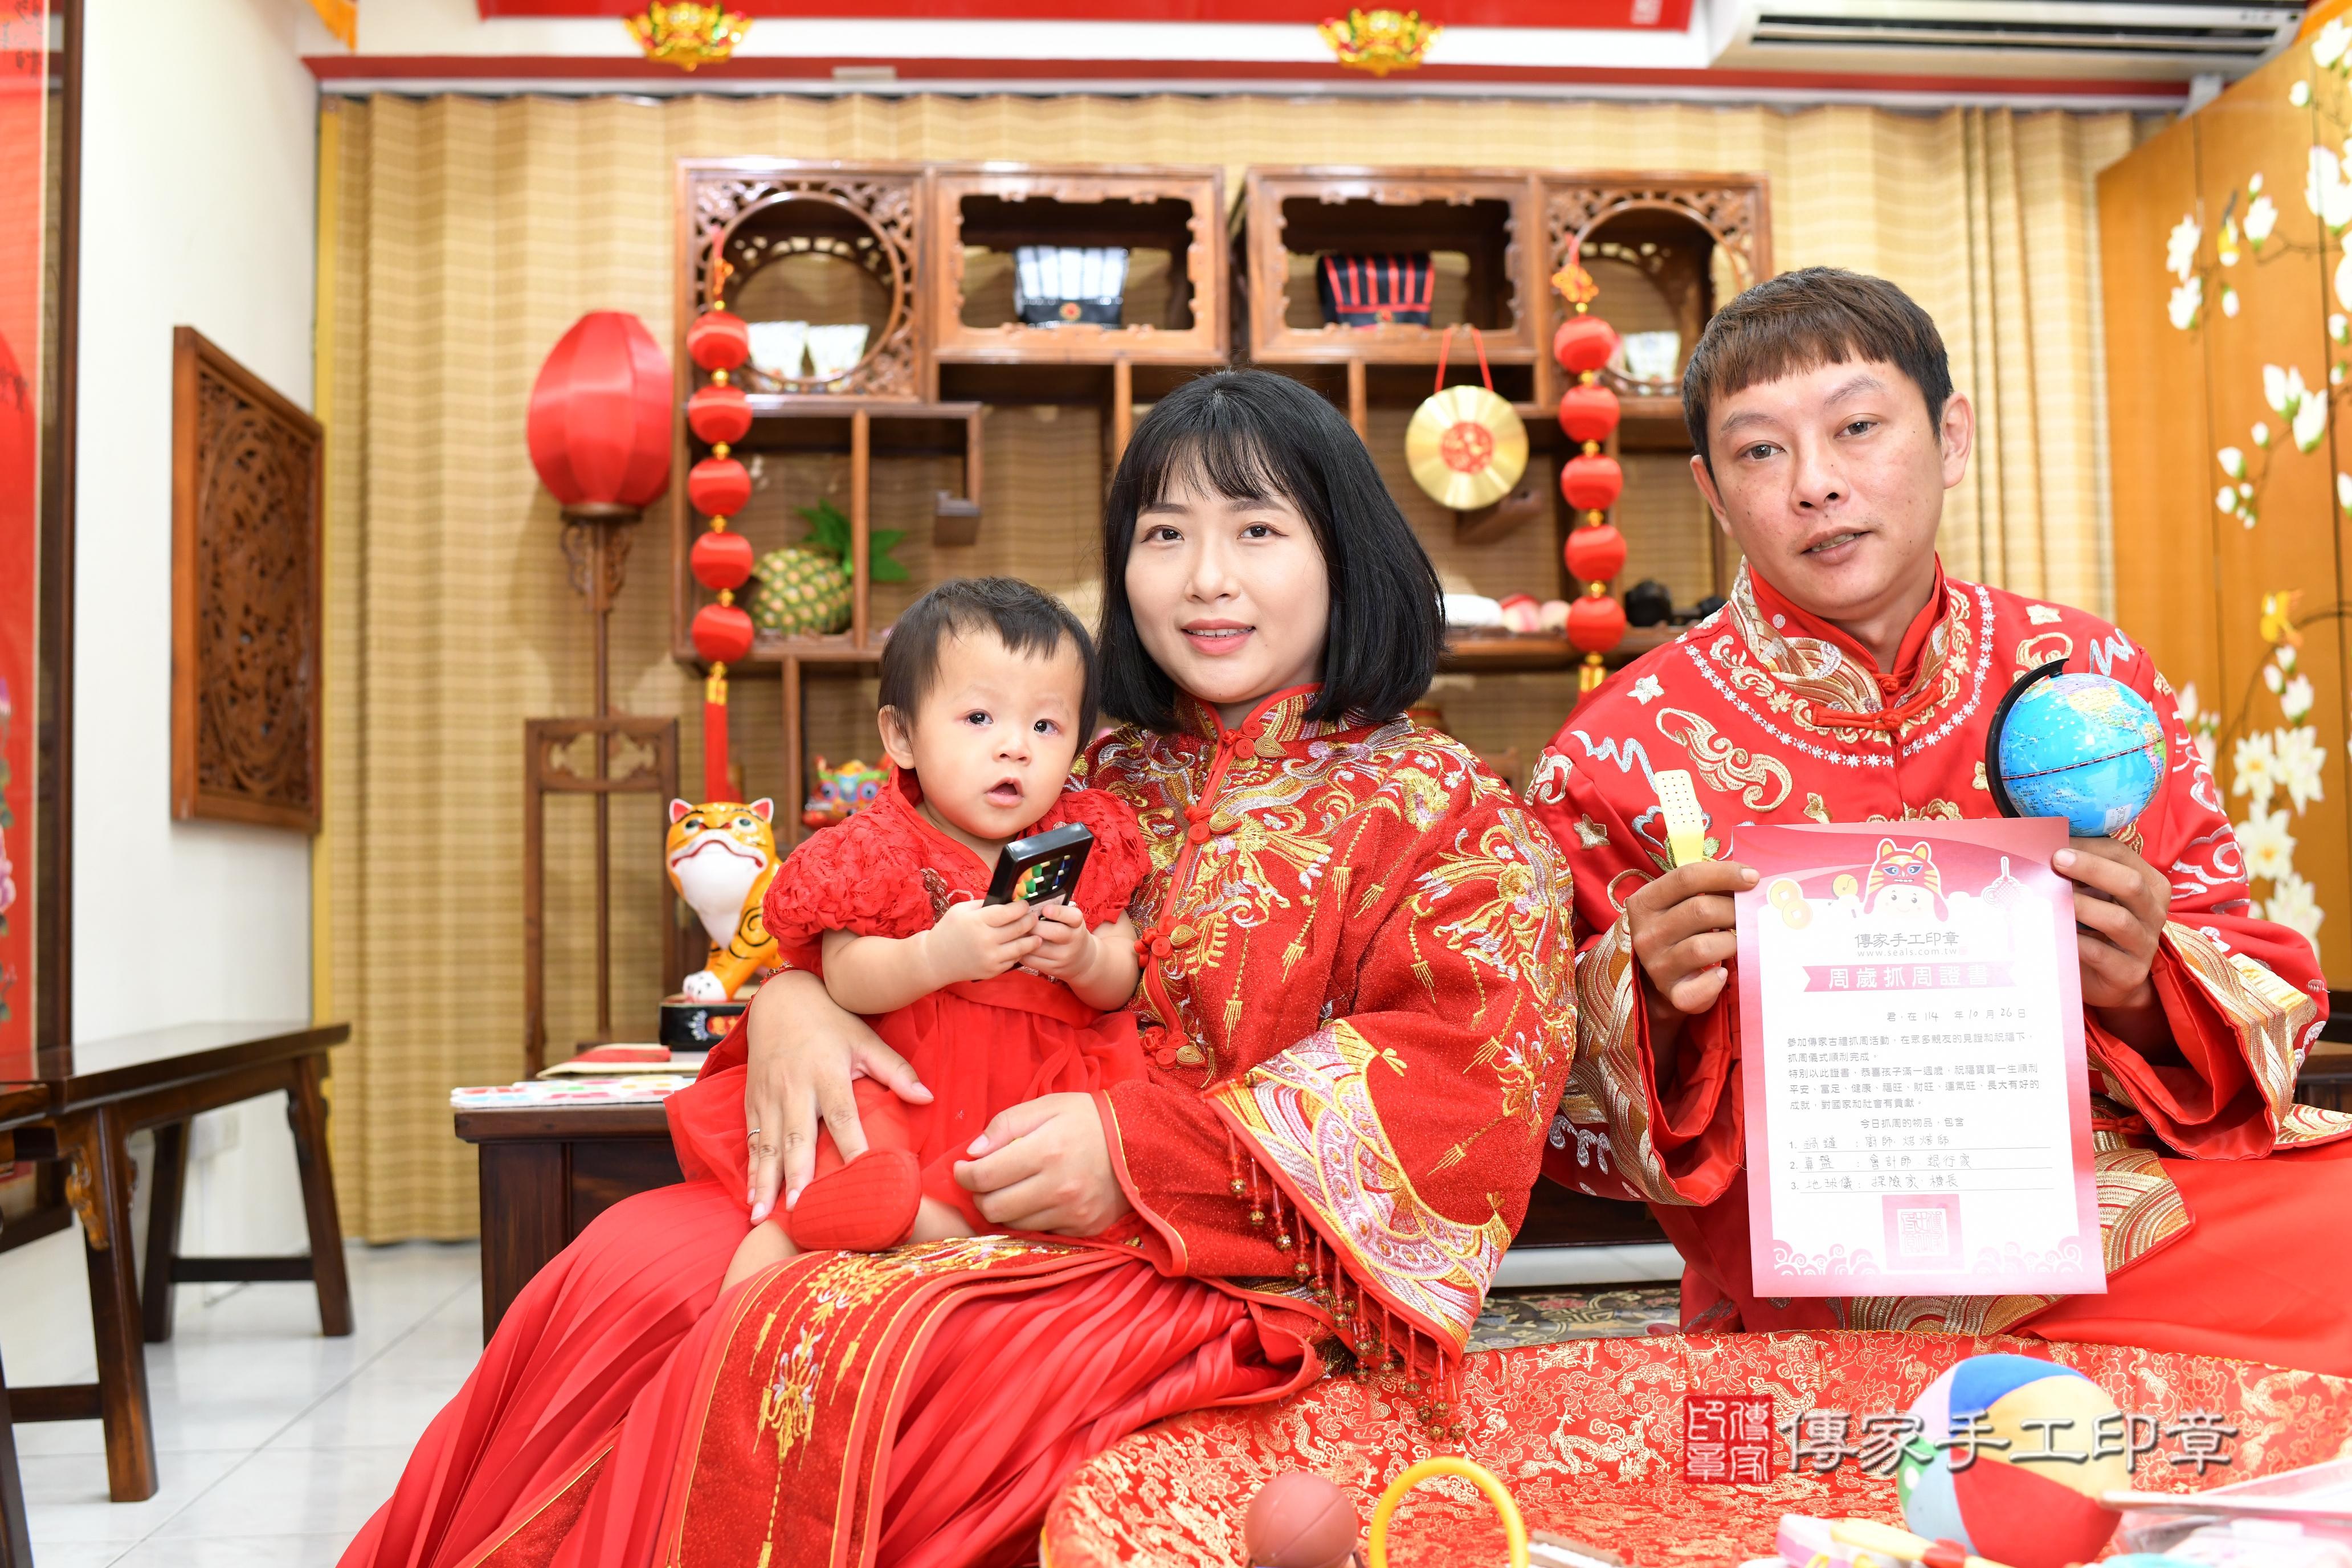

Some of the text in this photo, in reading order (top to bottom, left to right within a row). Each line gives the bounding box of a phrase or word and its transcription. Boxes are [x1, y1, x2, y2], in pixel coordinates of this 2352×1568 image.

[1855, 930, 1959, 948] 傳家手工印章
[1857, 948, 1957, 957] www.seals.com.tw
[1829, 965, 1988, 989] 周歲抓周證書
[1925, 1012, 1939, 1022] 114
[1954, 1011, 1963, 1020] 年
[1970, 1010, 1978, 1019] 10
[1986, 1010, 1994, 1019] 月
[2001, 1007, 2012, 1016] 26
[2018, 1009, 2025, 1018] 日
[1788, 1052, 1876, 1063] 抓周儀式順利完成。
[1790, 1099, 1921, 1110] 成就，對國家和社會有貢獻。
[1860, 1117, 1963, 1128] 今日抓周的物品，包含
